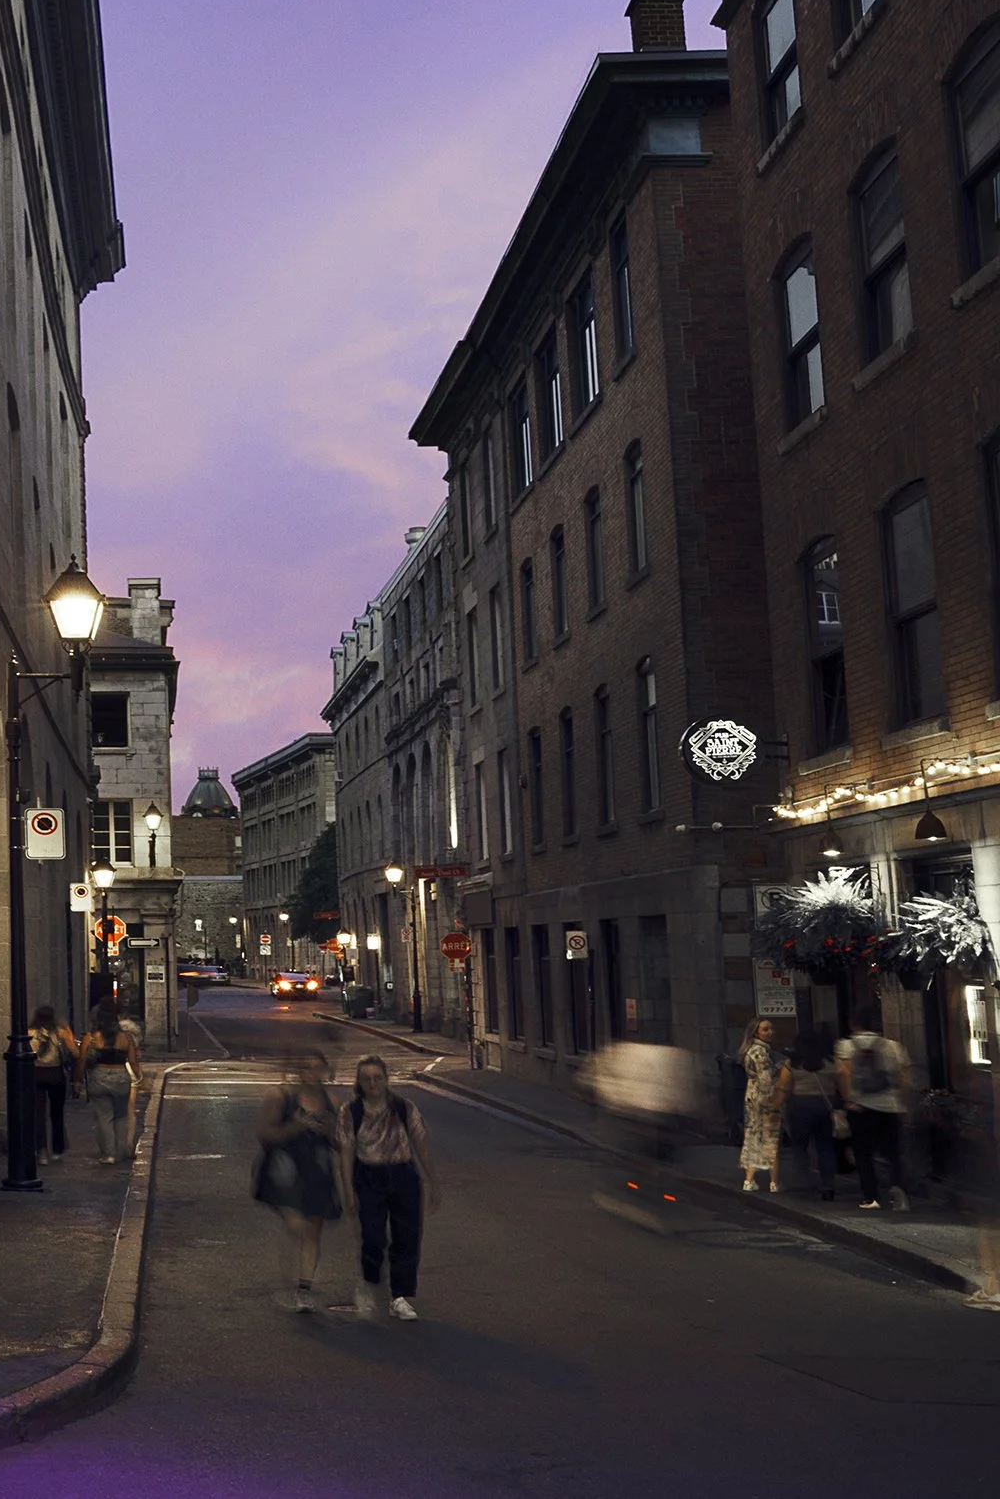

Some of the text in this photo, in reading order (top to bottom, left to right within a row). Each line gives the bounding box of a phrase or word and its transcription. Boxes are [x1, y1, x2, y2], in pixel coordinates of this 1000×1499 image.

[706, 737, 740, 748] SAINT
[705, 745, 743, 757] PIERRE
[97, 923, 124, 934] AÊT
[442, 939, 470, 952] ARRÊT
